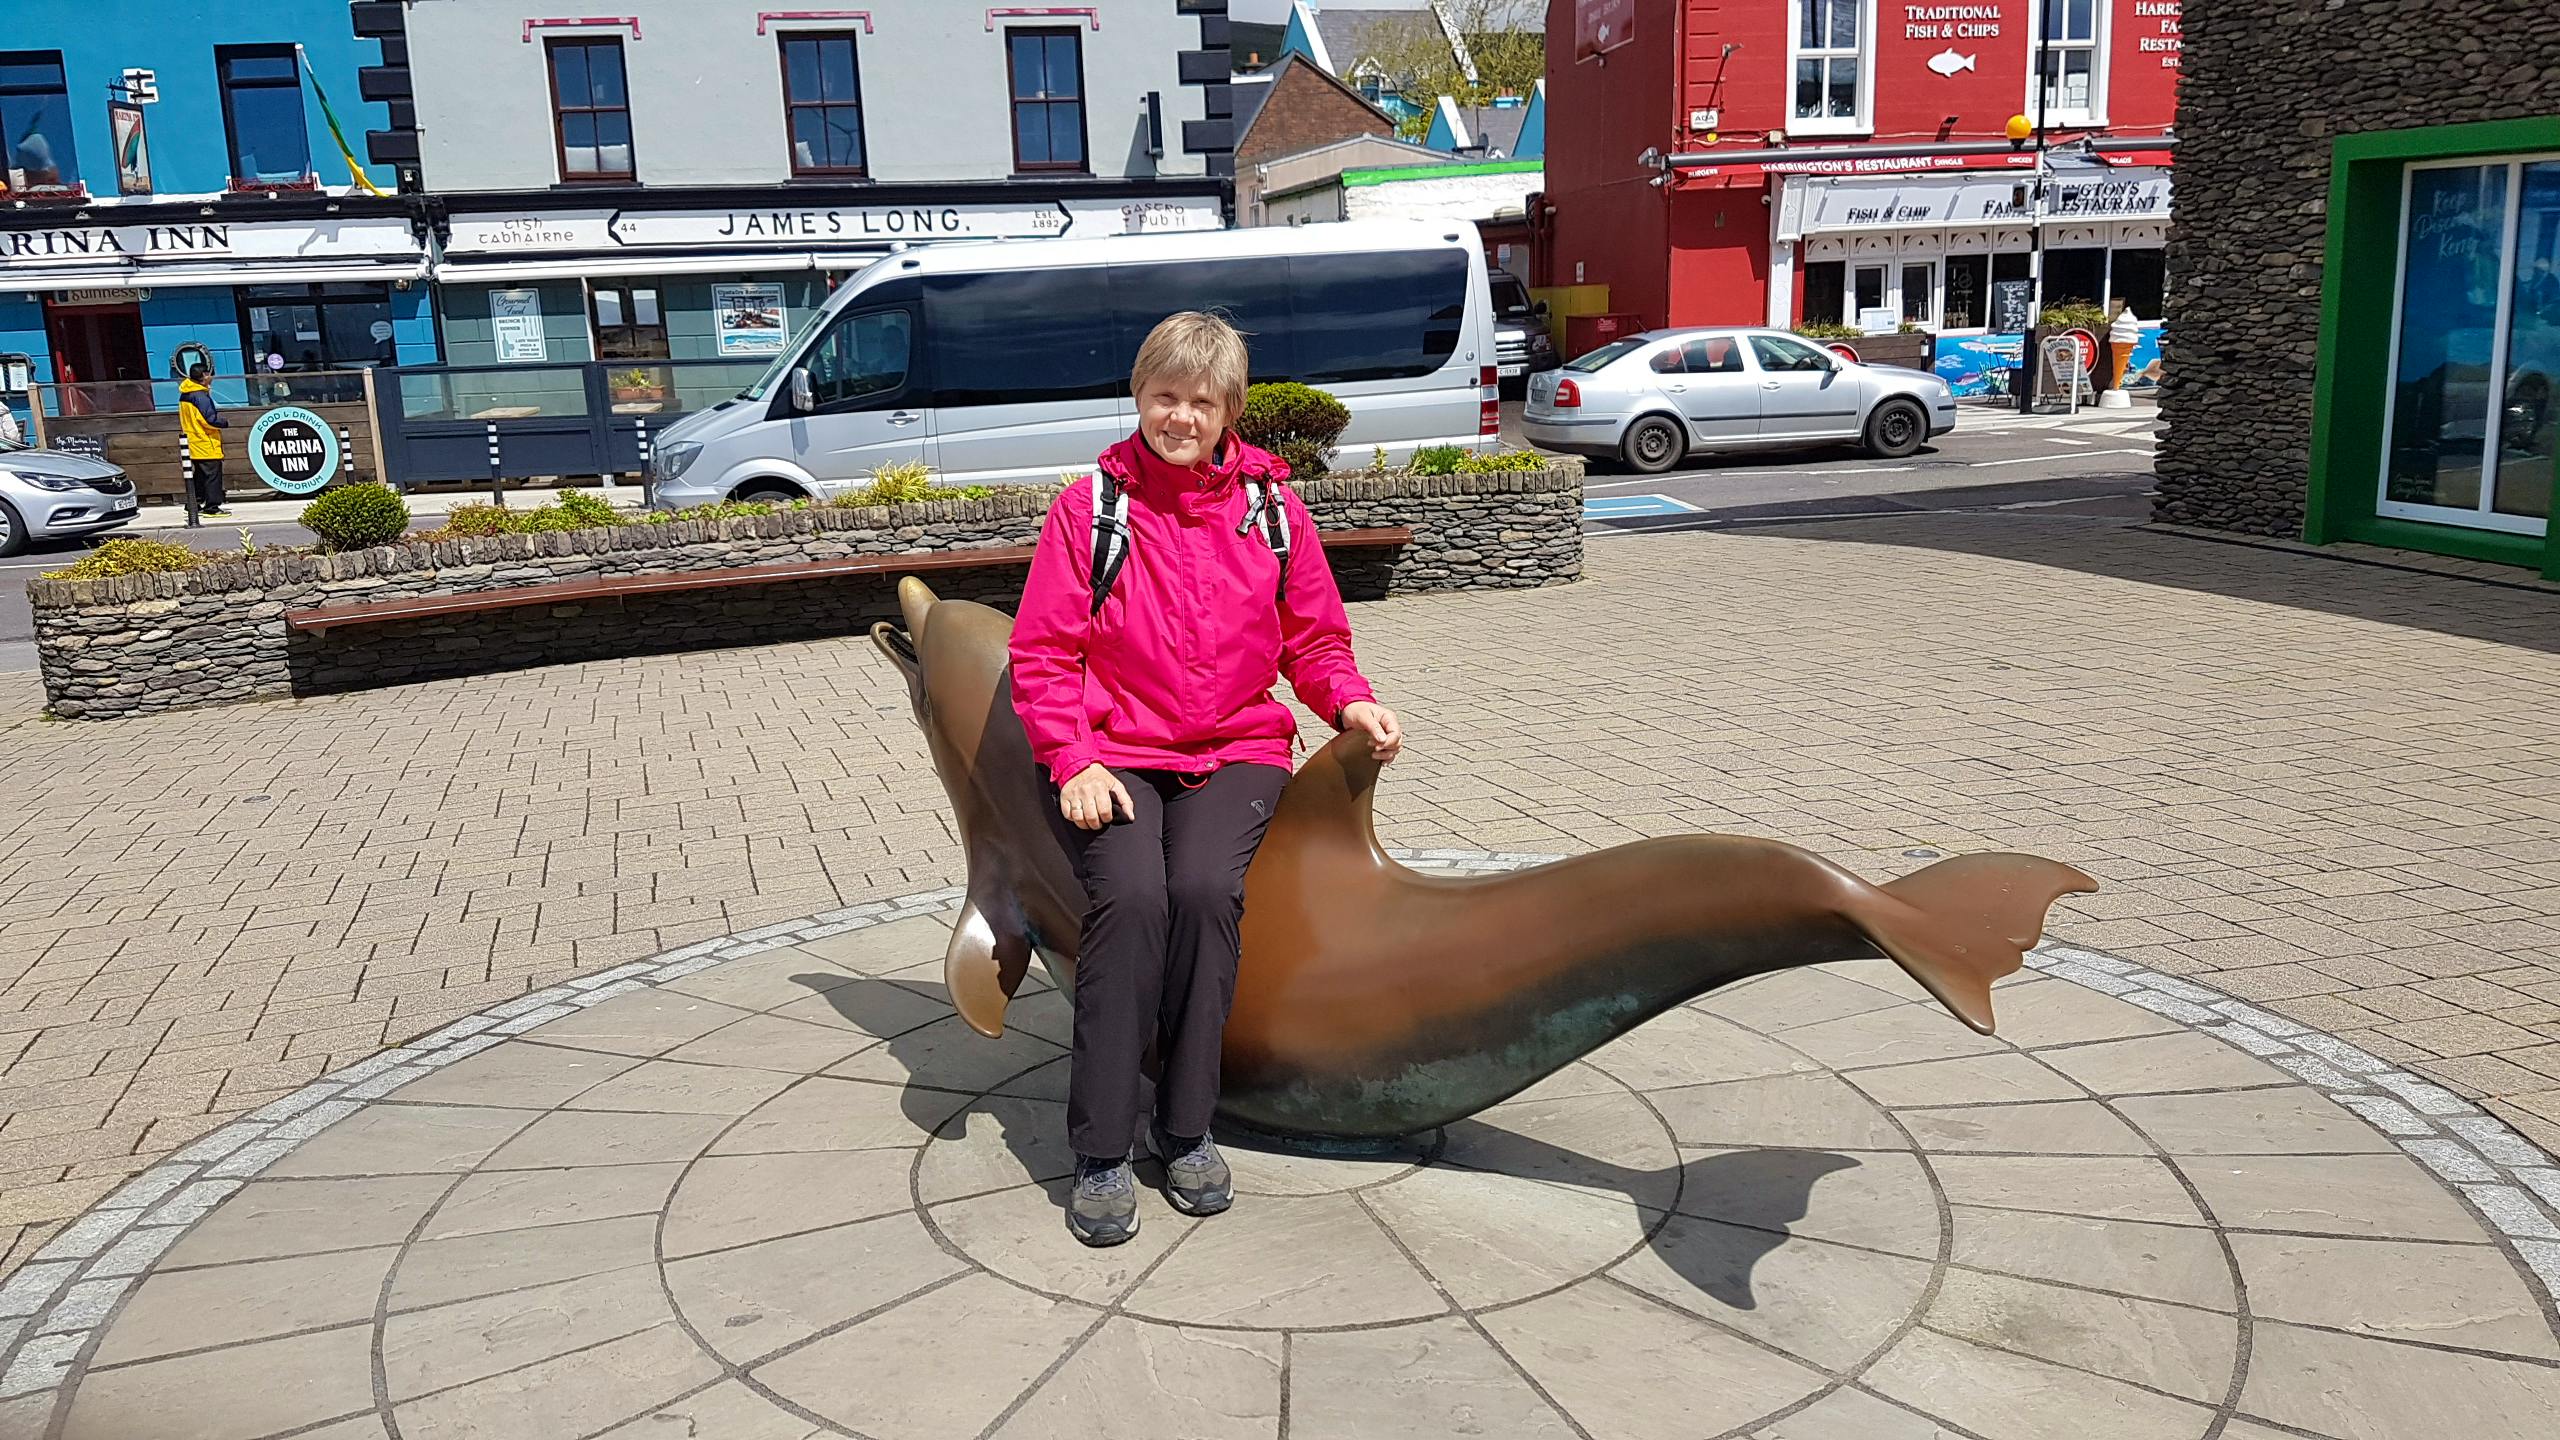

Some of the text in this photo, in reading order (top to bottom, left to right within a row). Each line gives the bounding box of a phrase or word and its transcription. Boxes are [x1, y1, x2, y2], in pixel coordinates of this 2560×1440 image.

[1904, 5, 2000, 20] TRADITIONAL
[1905, 23, 2000, 38] FISH & CHIPS
[2160, 19, 2182, 33] FA
[2139, 37, 2185, 51] RESTA
[1760, 157, 1964, 172] HARRINGTON'S RESTAURANT DINGLE
[2007, 156, 2033, 164] CHICKEN
[2063, 196, 2160, 211] ESTAURANT
[1848, 205, 1931, 220] FISH & CHIP
[620, 223, 637, 233] 44
[718, 208, 971, 236] JAMES LONG.
[1032, 219, 1059, 228] 1892
[0, 224, 230, 257] RINA INN
[257, 412, 281, 432] FOOD
[292, 411, 323, 430] DRINK
[282, 427, 299, 437] THE
[263, 438, 323, 456] MARINA
[281, 456, 310, 472] INN
[273, 475, 324, 490] EMPORIUM
